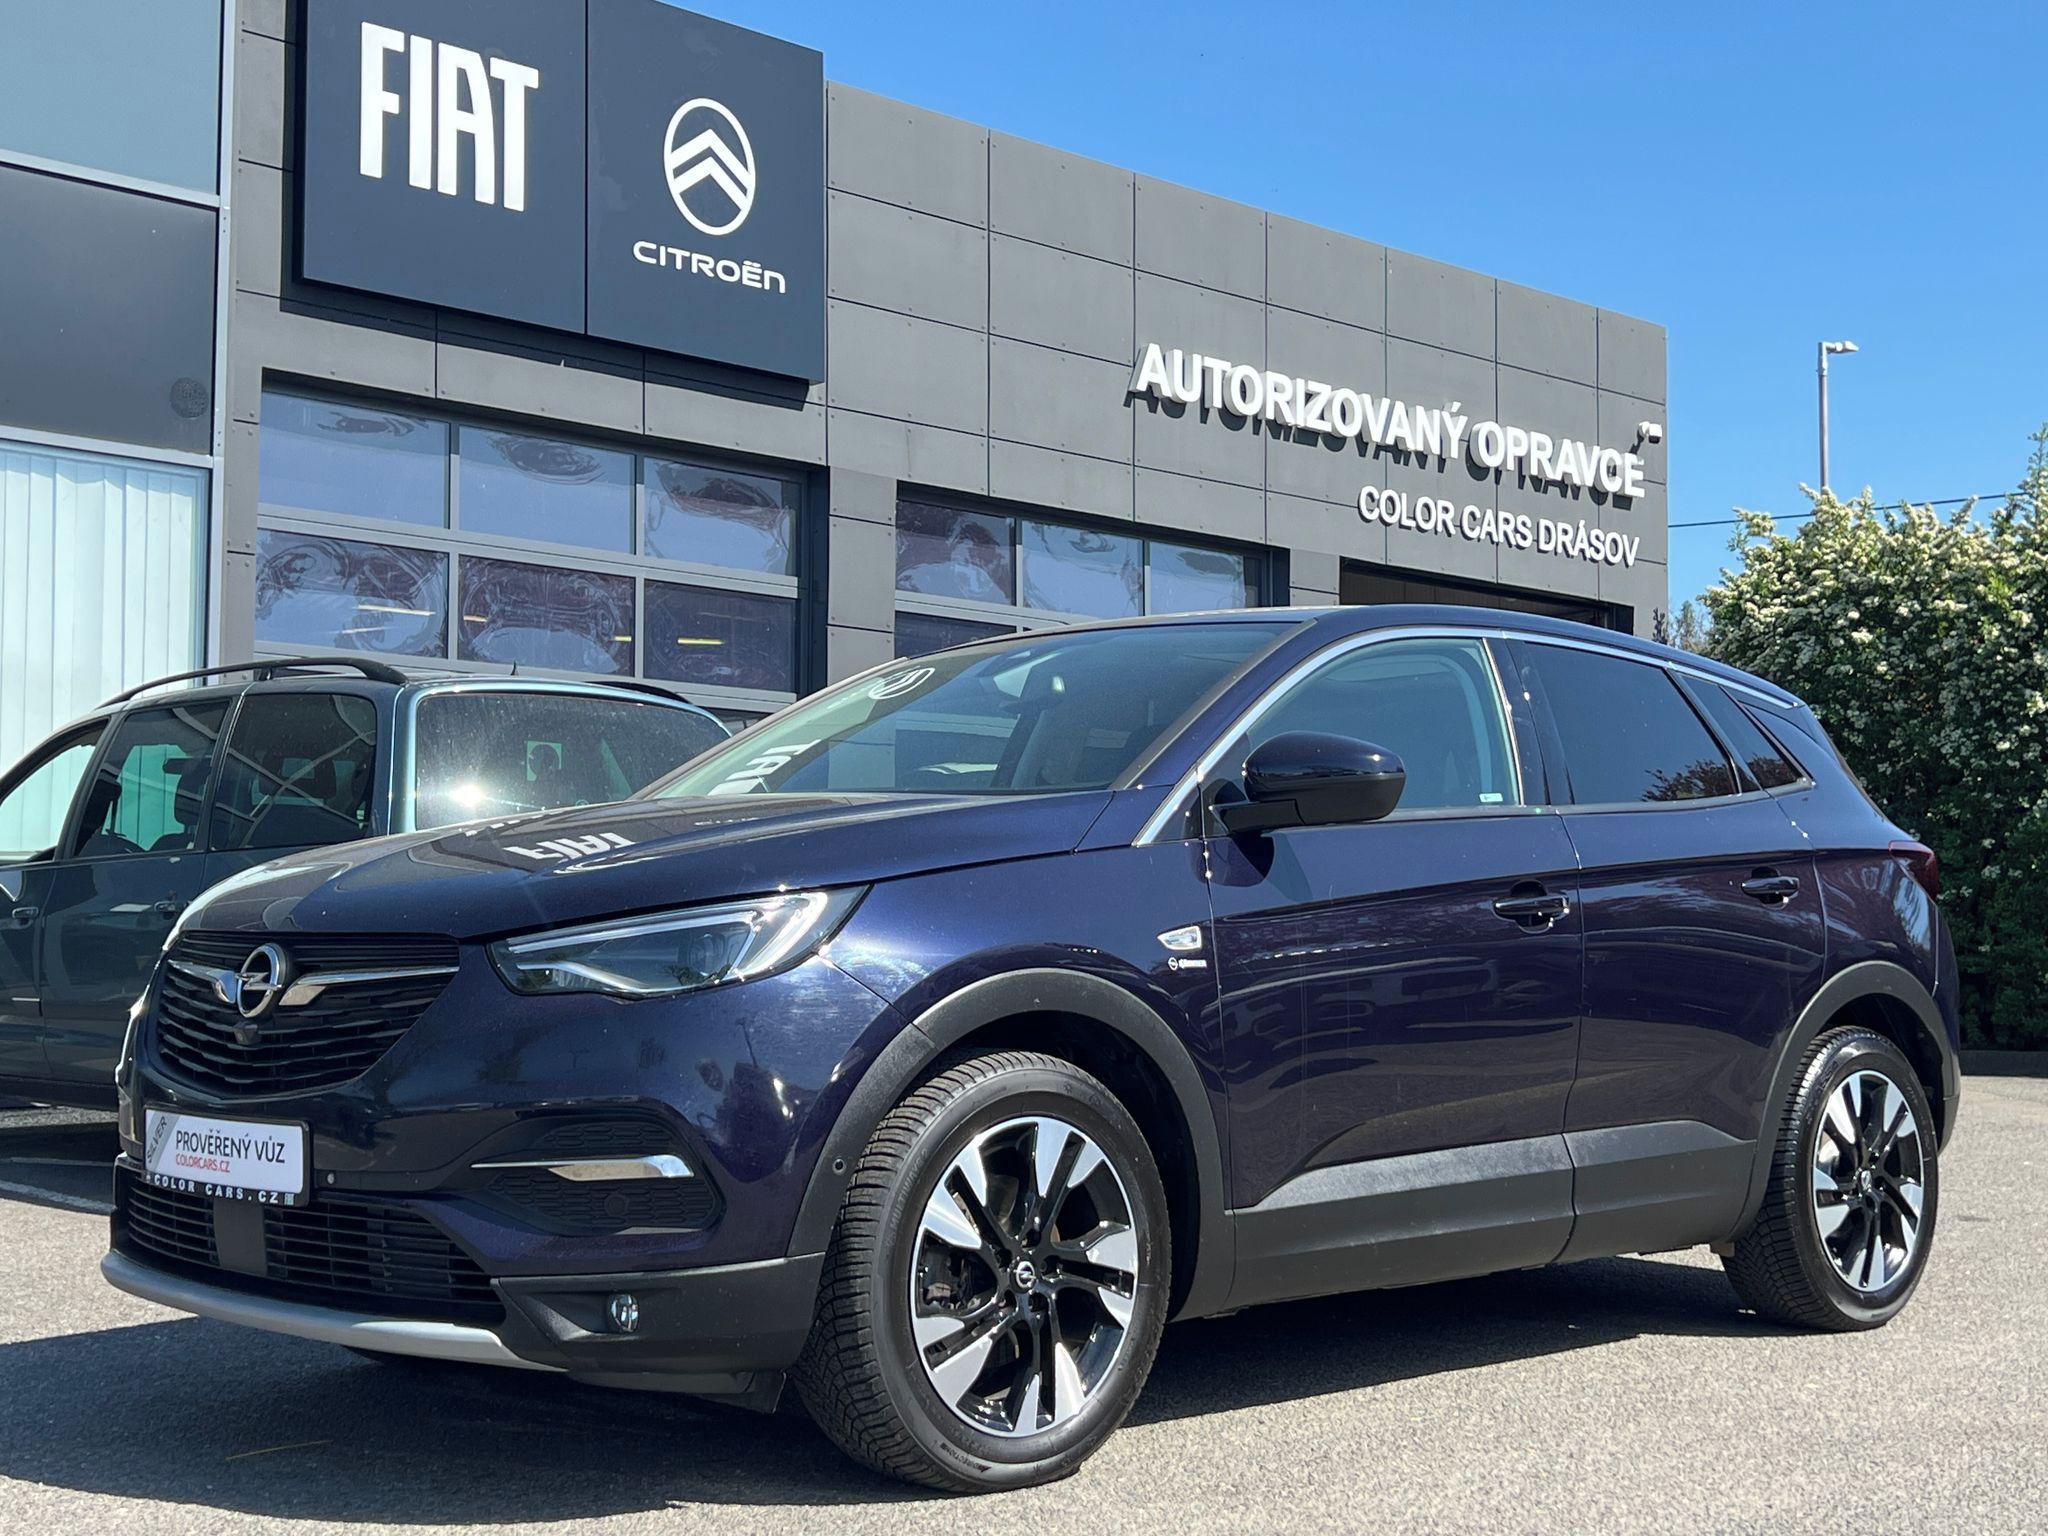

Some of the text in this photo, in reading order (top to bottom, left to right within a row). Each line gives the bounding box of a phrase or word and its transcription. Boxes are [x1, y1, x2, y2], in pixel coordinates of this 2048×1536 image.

[360, 20, 540, 213] FIAT
[632, 240, 787, 294] CITROËN
[1128, 342, 1646, 498] AUTORIZOVANÝ OPRAVCE
[1359, 485, 1640, 567] COLOR CARS DRÁSOV
[175, 1128, 286, 1164] PROVĚŘENÝ VŮZ
[175, 1153, 231, 1174] COLORCARS.CZ
[153, 1173, 196, 1193] COLOR
